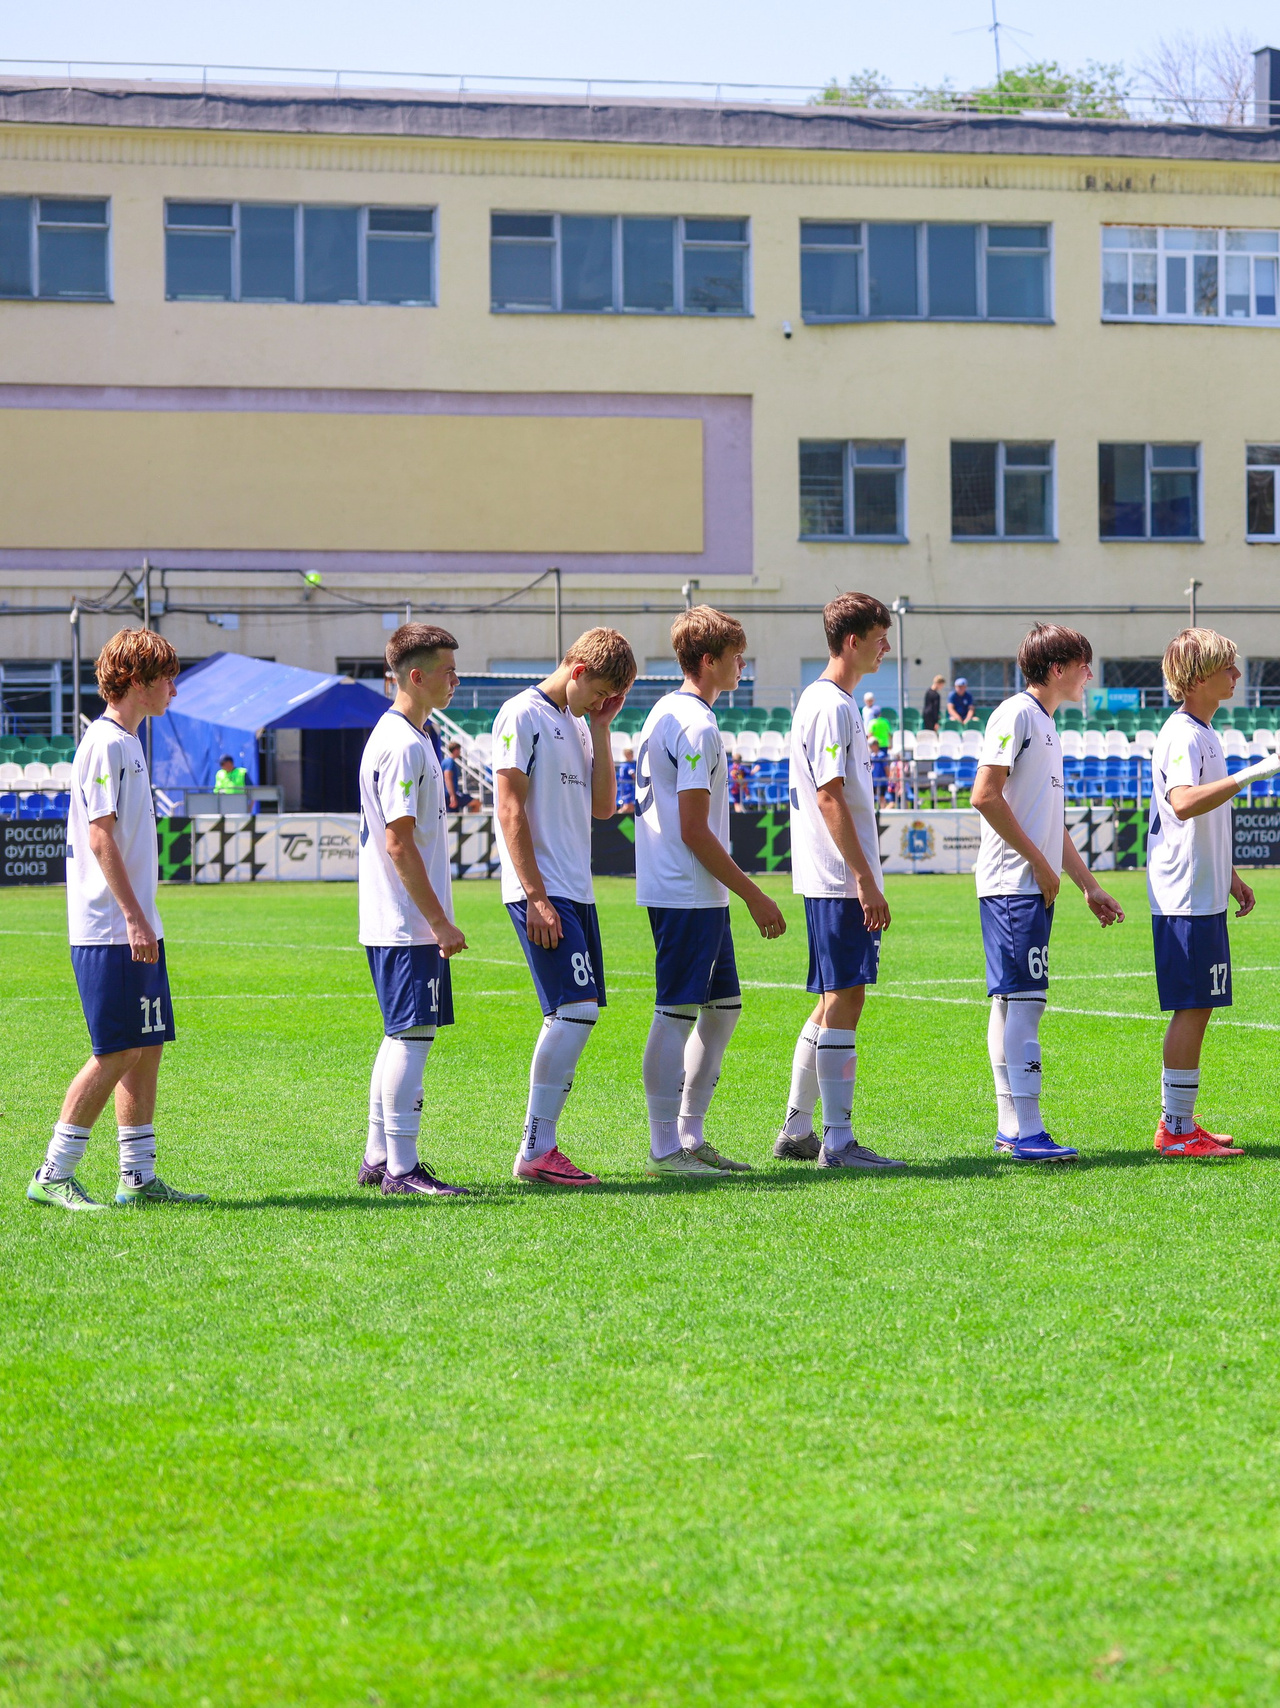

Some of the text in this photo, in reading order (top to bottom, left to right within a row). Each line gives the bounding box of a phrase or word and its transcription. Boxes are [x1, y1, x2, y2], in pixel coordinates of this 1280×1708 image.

[4, 843, 67, 859] ФУТБОЛ
[318, 847, 359, 860] ТРАН
[1234, 845, 1270, 858] СОЮЗ
[5, 861, 48, 876] СОЮЗ
[1209, 962, 1228, 996] 17
[140, 996, 166, 1034] 11
